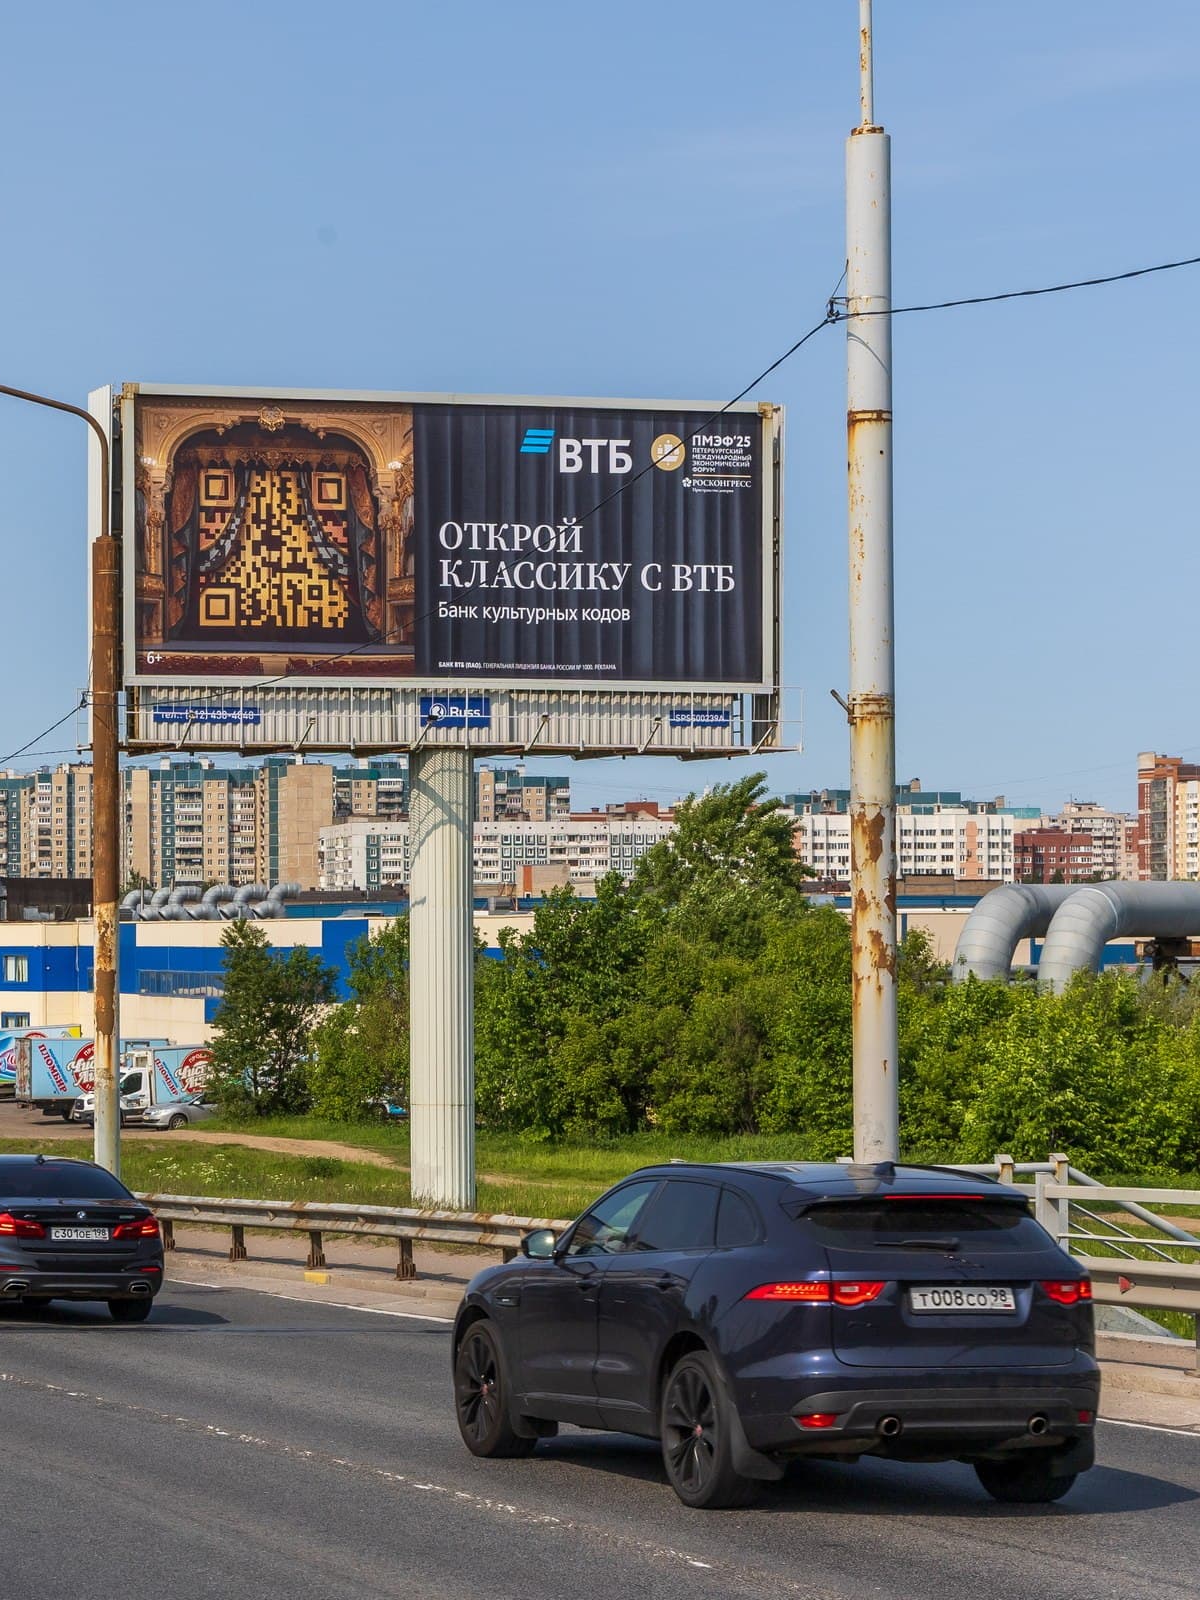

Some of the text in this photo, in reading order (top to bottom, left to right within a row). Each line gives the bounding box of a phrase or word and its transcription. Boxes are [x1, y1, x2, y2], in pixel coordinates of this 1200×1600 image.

[692, 434, 751, 447] ПМЭФ'25
[559, 437, 633, 474] ВТБ
[692, 479, 752, 488] РОСКОНГРЕСС
[439, 517, 583, 553] ОТКРОЙ
[439, 559, 736, 593] КЛАССИКУ С ВТБ
[438, 601, 631, 625] Банк культурных кодов
[146, 651, 163, 664] 6+
[450, 707, 480, 717] Russ
[38, 1043, 68, 1093] ПЛОМБИР
[154, 1058, 179, 1096] ПЛОМБИР
